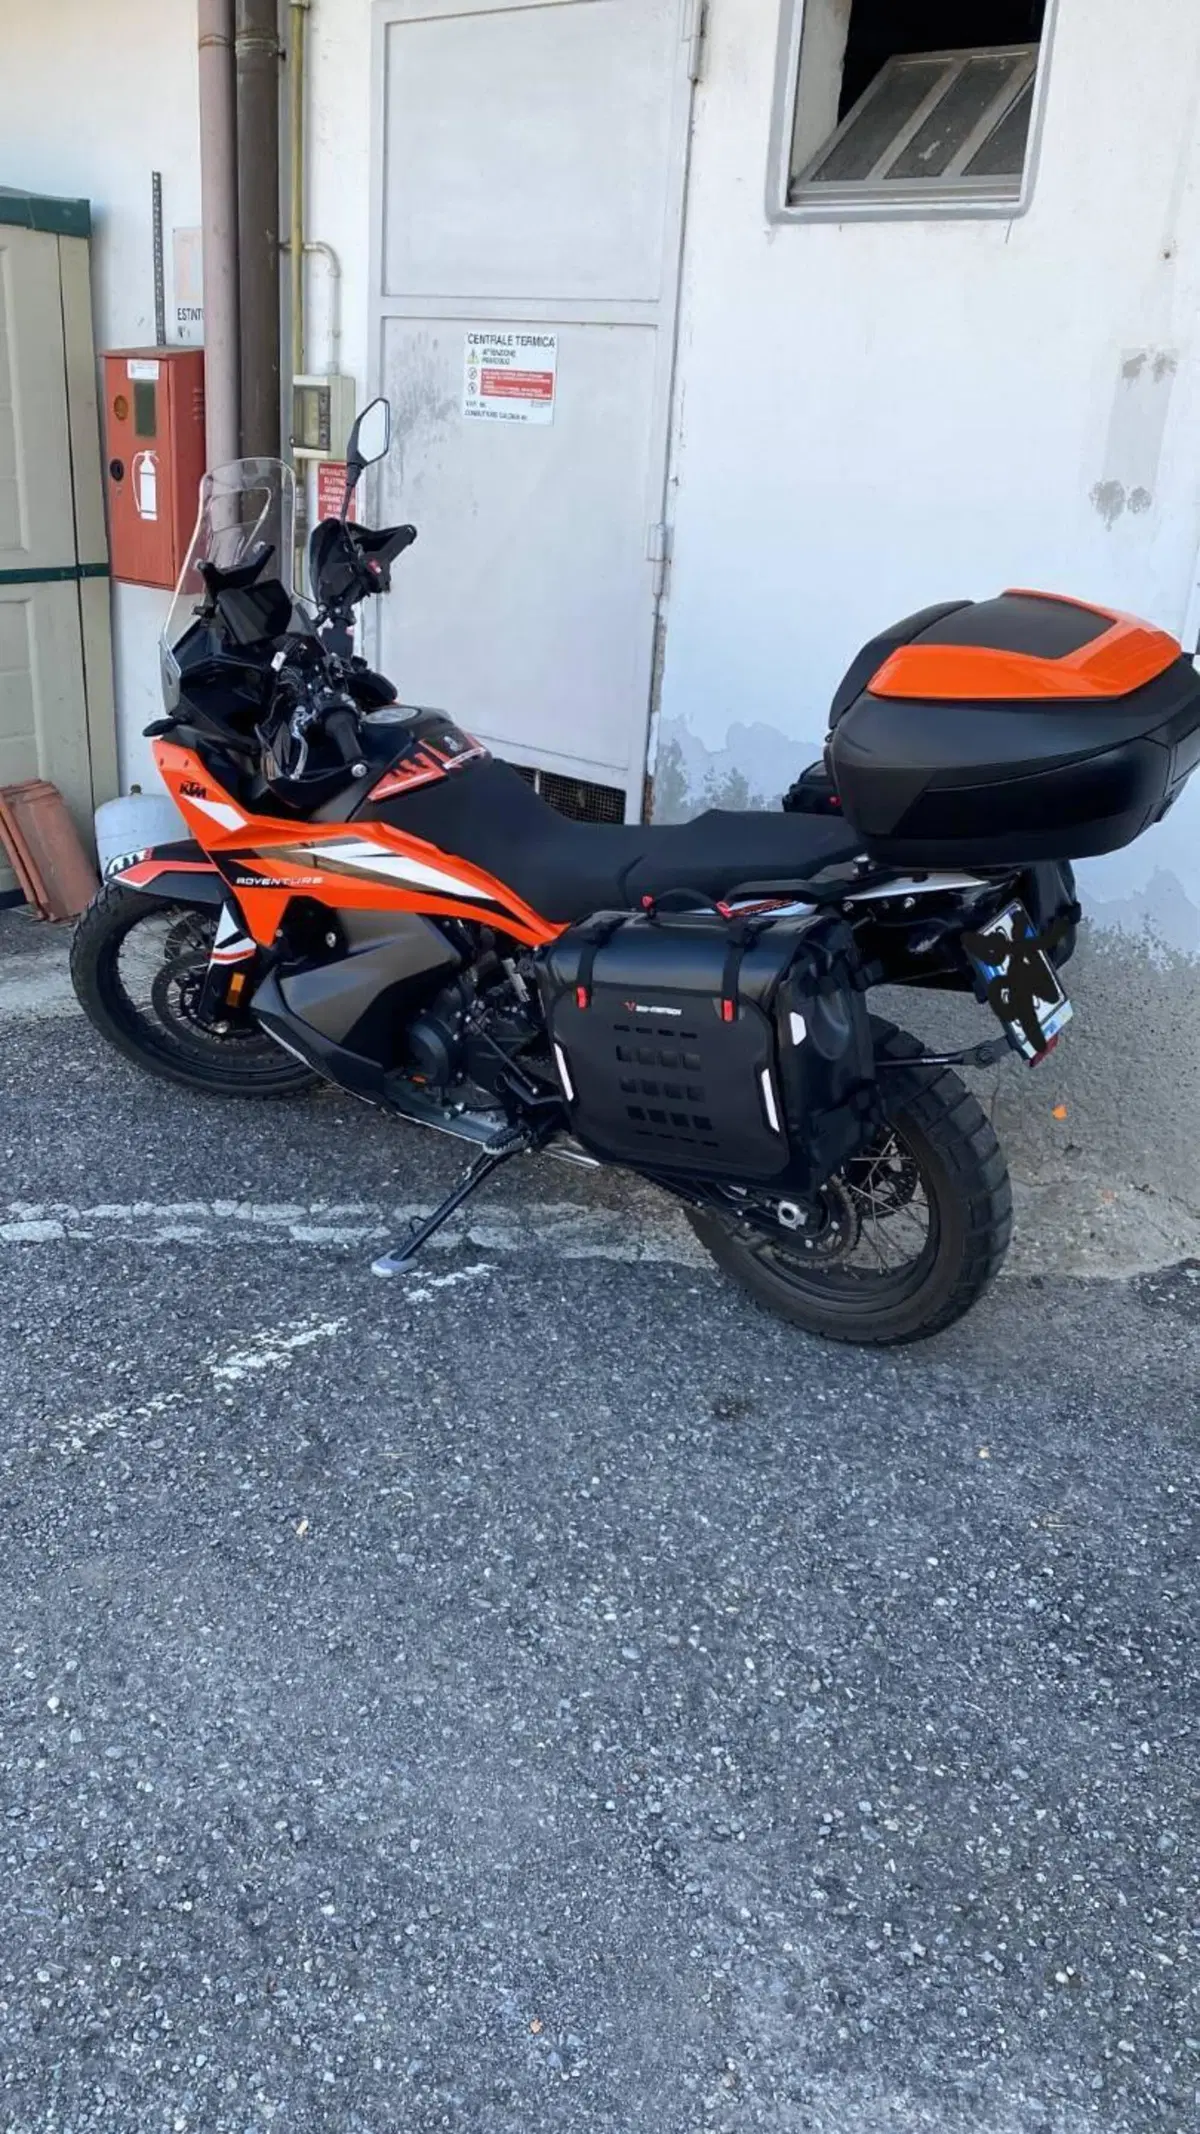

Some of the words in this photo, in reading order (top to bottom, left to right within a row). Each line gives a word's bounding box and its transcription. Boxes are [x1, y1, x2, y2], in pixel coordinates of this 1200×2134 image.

[467, 333, 513, 346] CENTRALE
[516, 336, 555, 347] TERMICA
[179, 780, 207, 799] KTM
[236, 876, 323, 886] ADVENTURE
